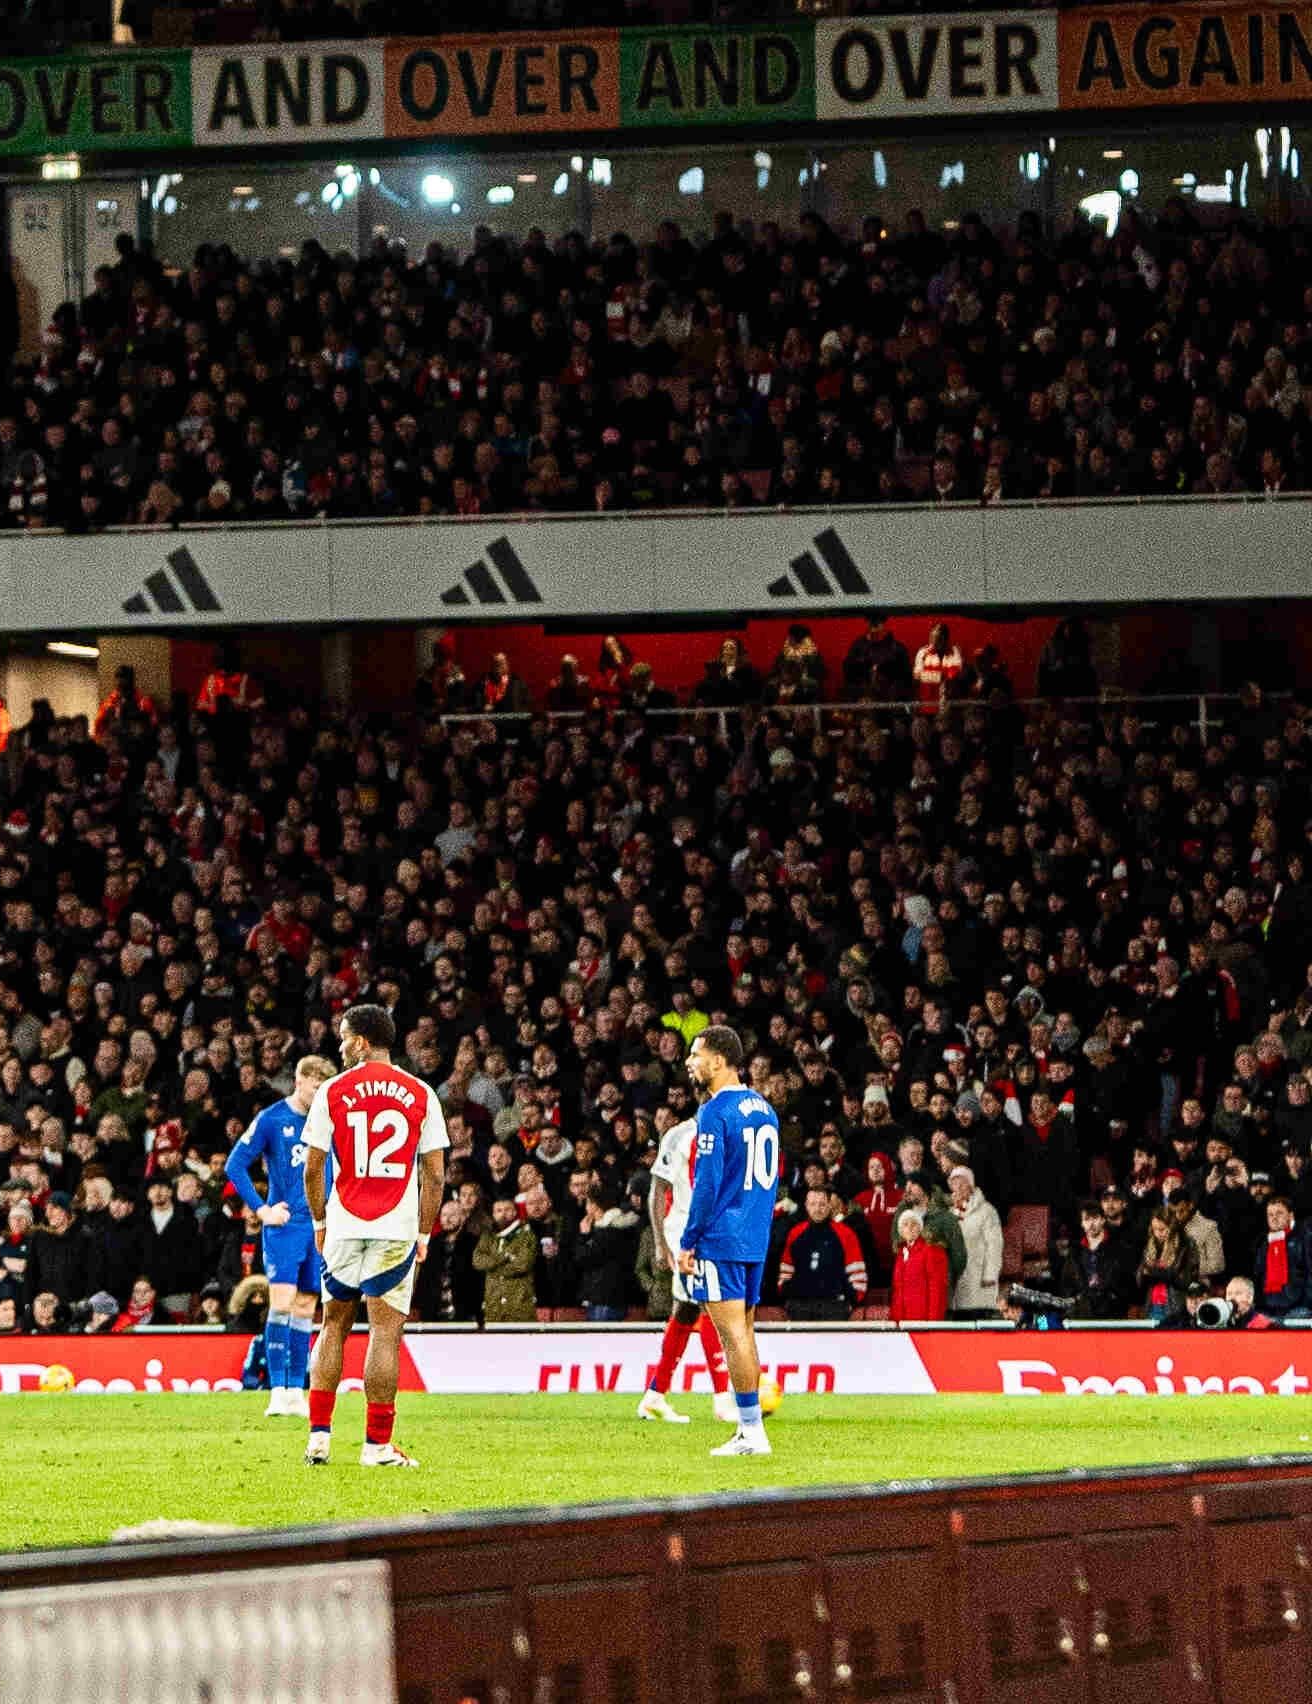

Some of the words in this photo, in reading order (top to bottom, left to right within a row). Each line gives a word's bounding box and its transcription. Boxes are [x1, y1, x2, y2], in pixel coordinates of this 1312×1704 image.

[207, 53, 371, 131] AND
[399, 44, 602, 122] OVER
[636, 34, 802, 111] AND
[830, 22, 1042, 103] OVER
[1075, 13, 1312, 93] AGAIN
[355, 1080, 416, 1109] TIMBER
[346, 1109, 410, 1179] 12
[742, 1124, 780, 1191] 10
